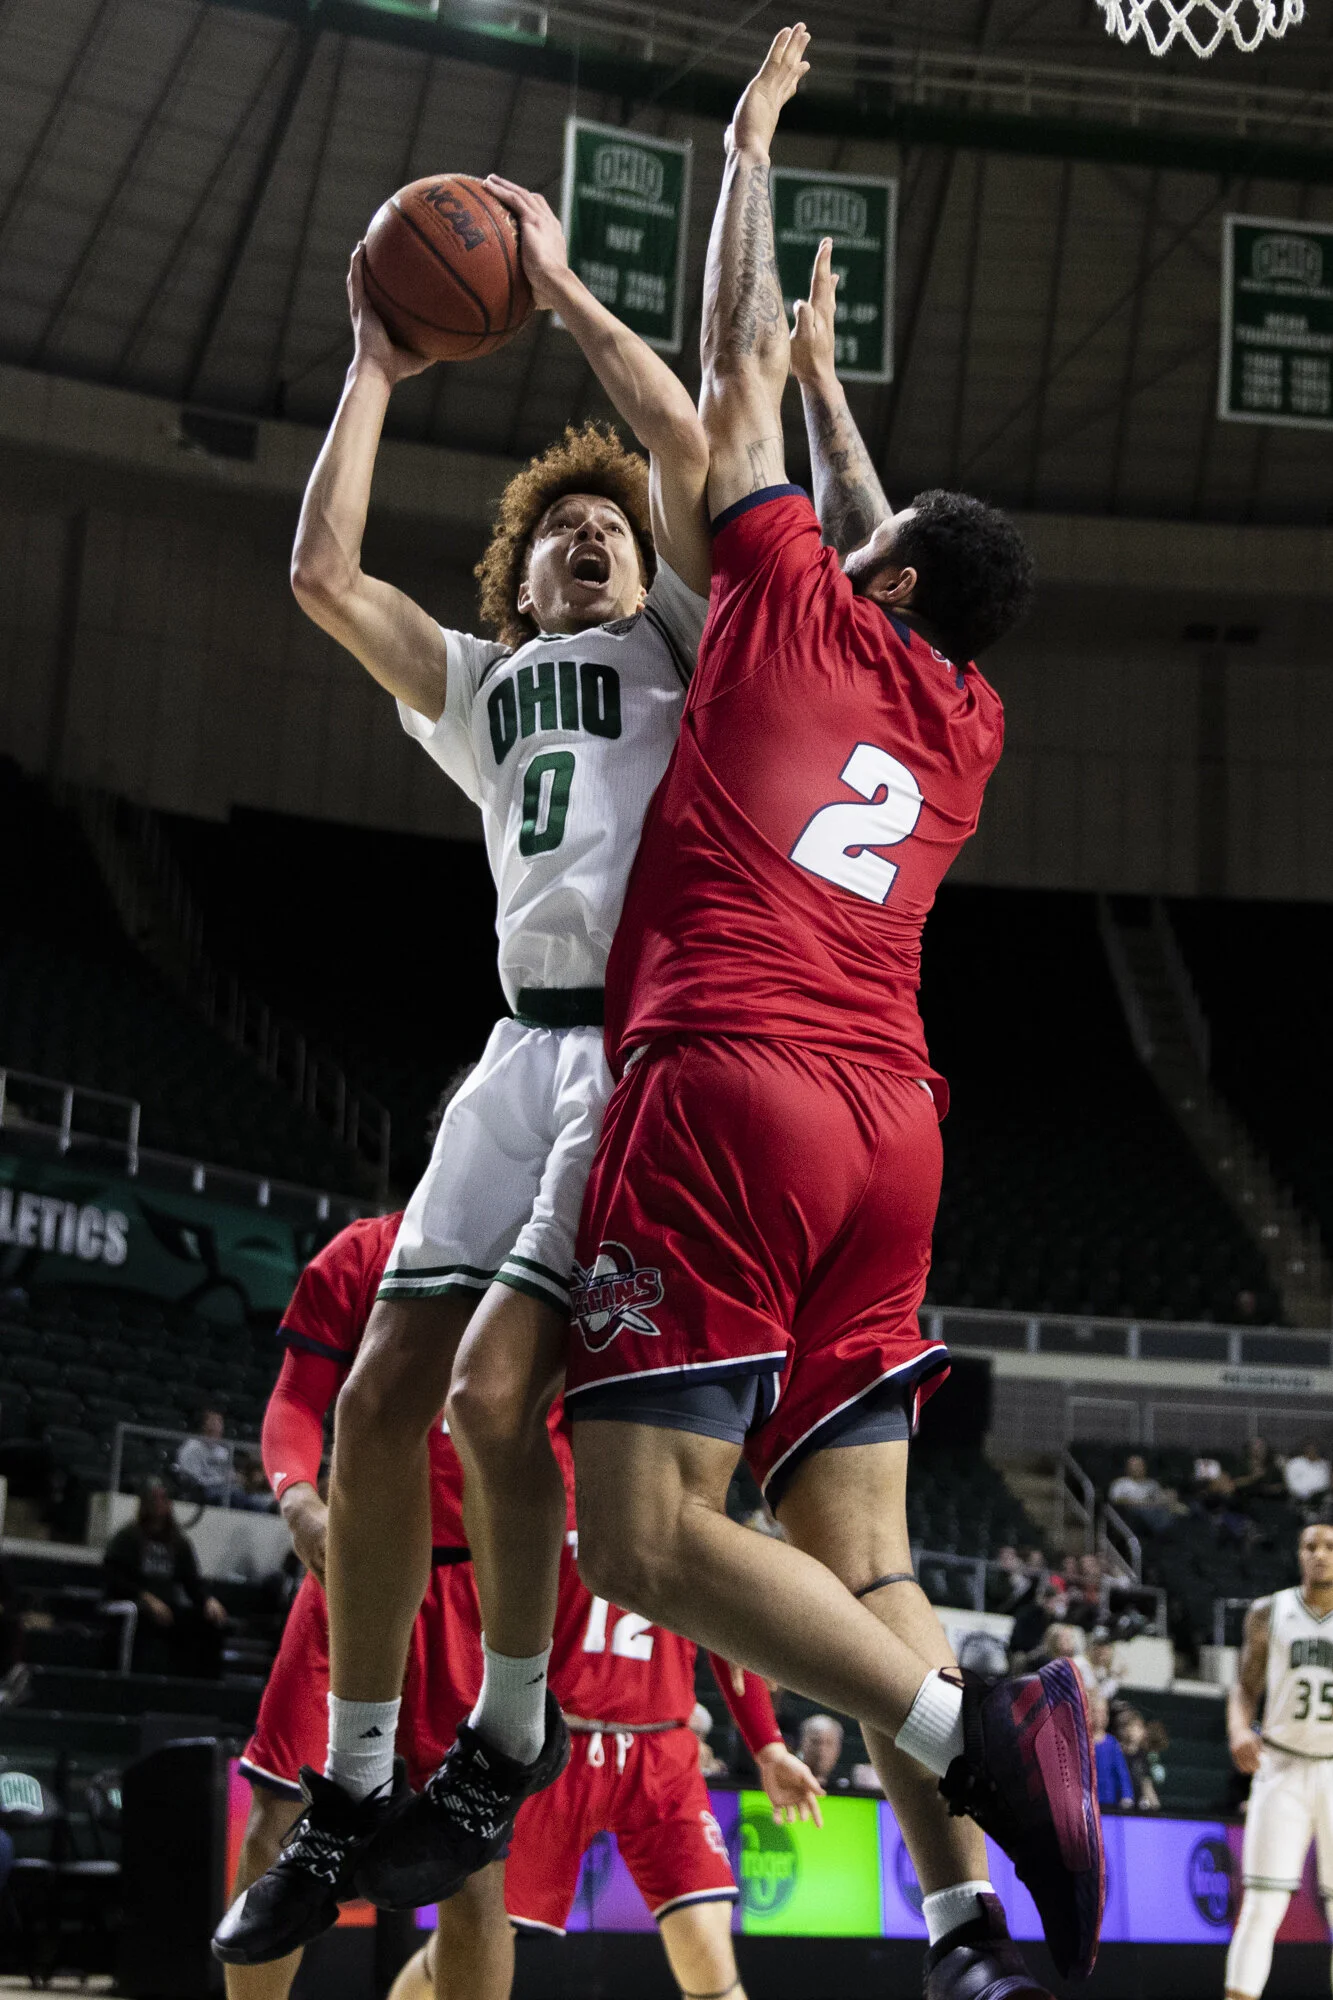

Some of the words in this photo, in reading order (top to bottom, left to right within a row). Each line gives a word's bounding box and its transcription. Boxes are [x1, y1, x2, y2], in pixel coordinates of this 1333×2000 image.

[419, 185, 486, 252] NCAA
[487, 661, 622, 765] OHIO
[519, 751, 575, 858] 0
[789, 742, 924, 905] 2
[0, 1187, 130, 1267] LETICS
[582, 1595, 655, 1662] 12
[1293, 1679, 1333, 1721] 35
